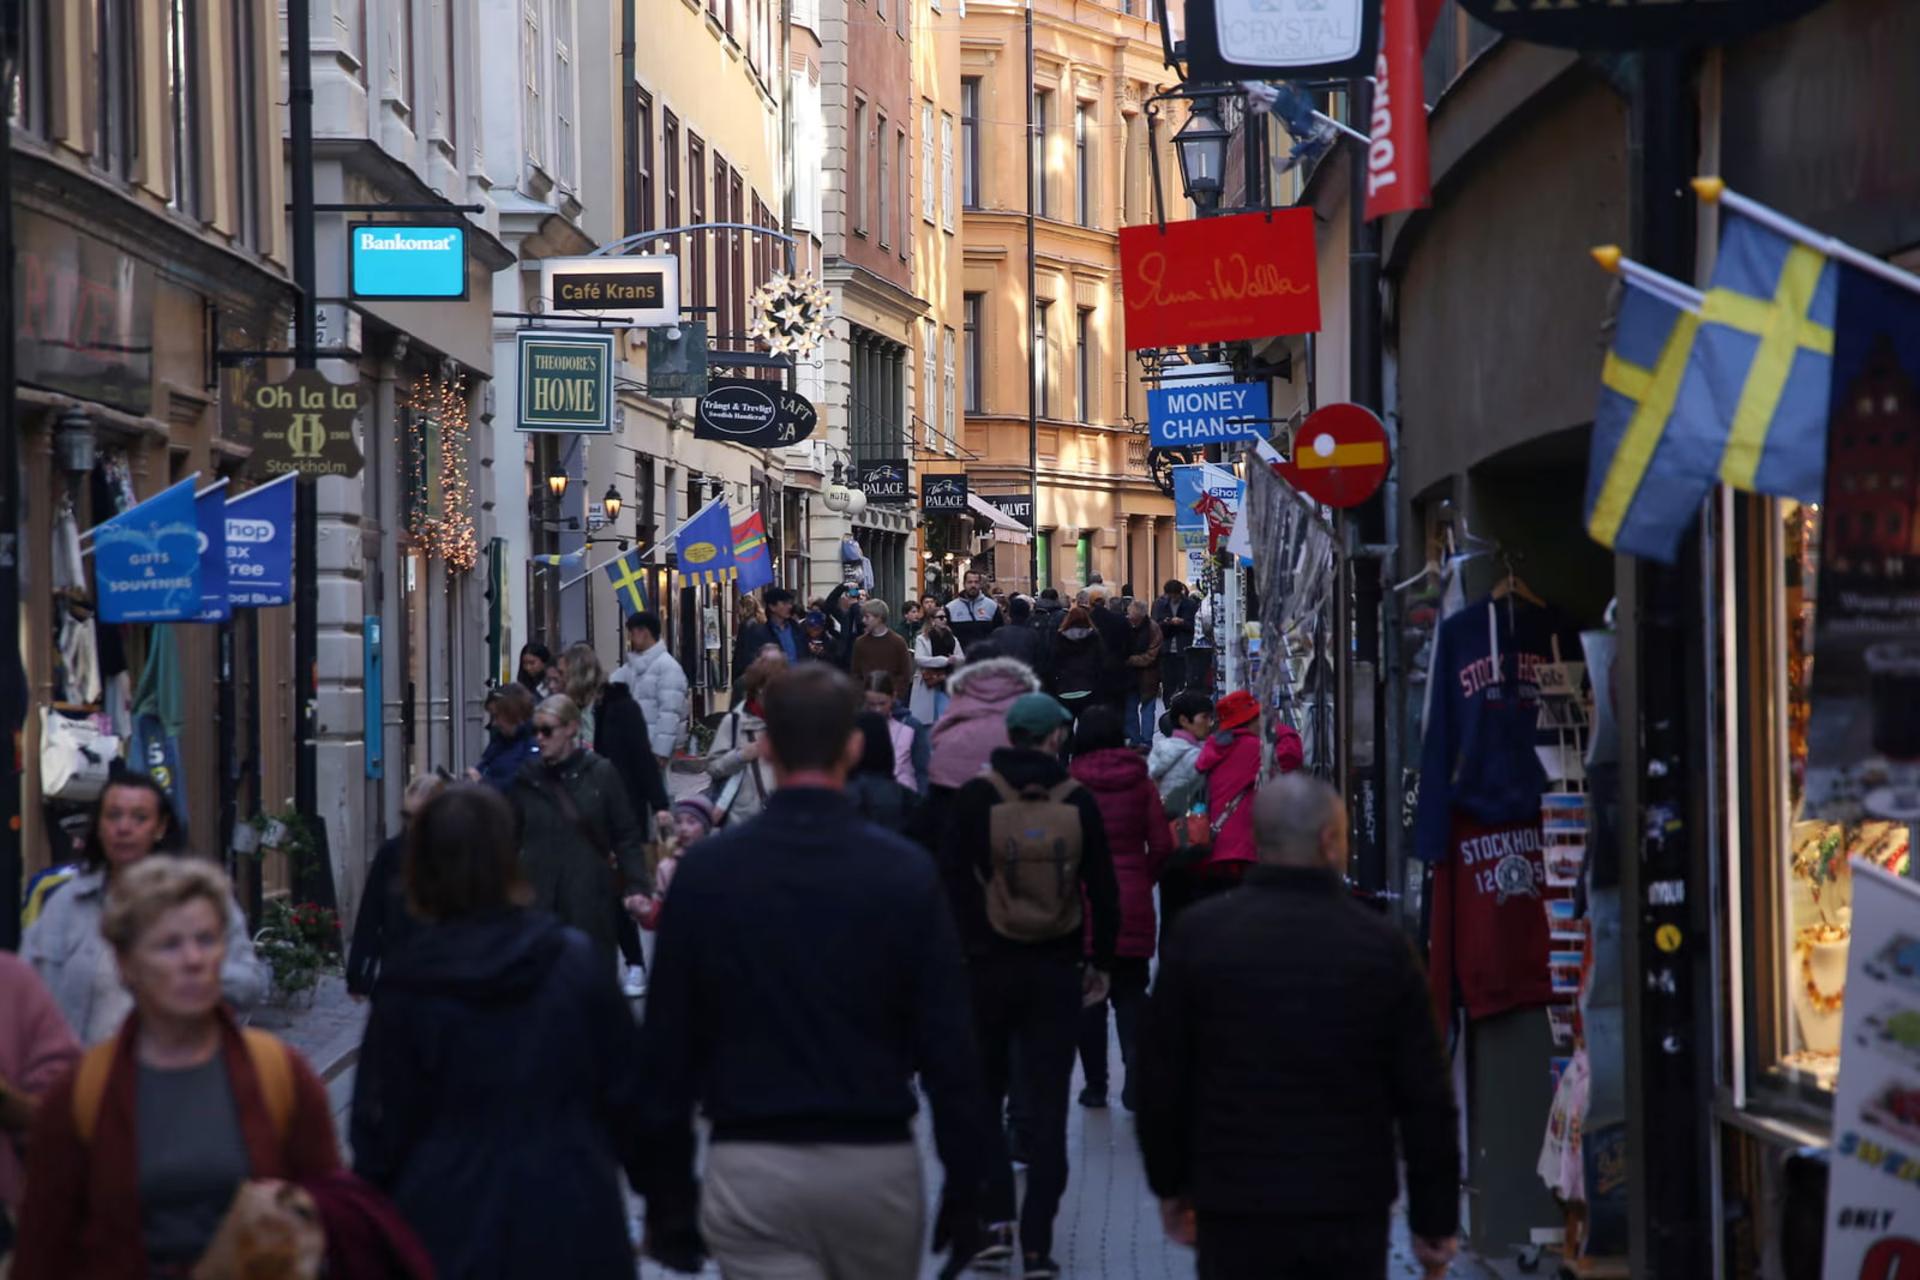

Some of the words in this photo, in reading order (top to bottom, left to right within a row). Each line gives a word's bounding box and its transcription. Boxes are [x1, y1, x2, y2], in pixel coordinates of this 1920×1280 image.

[1229, 18, 1353, 45] CRYSTAL
[561, 283, 601, 299] Café
[606, 283, 656, 299] Krans
[534, 354, 597, 372] THEODORE'S
[256, 386, 293, 409] Oh
[300, 386, 325, 409] la
[331, 386, 357, 409] la
[533, 377, 596, 413] HOME
[1167, 390, 1247, 414] MONEY
[731, 402, 740, 411] &
[741, 404, 772, 414] Trevligt
[1162, 414, 1256, 439] CHANGE
[265, 459, 347, 473] Stockholm
[829, 491, 850, 501] HOTE
[862, 482, 904, 495] PALACE
[925, 494, 964, 507] PALACE
[1000, 503, 1031, 516] VALVET
[228, 523, 270, 540] hop
[129, 552, 170, 566] GIFTS
[227, 545, 250, 559] ax
[144, 566, 155, 577] &
[1837, 1206, 1896, 1231] ONLY
